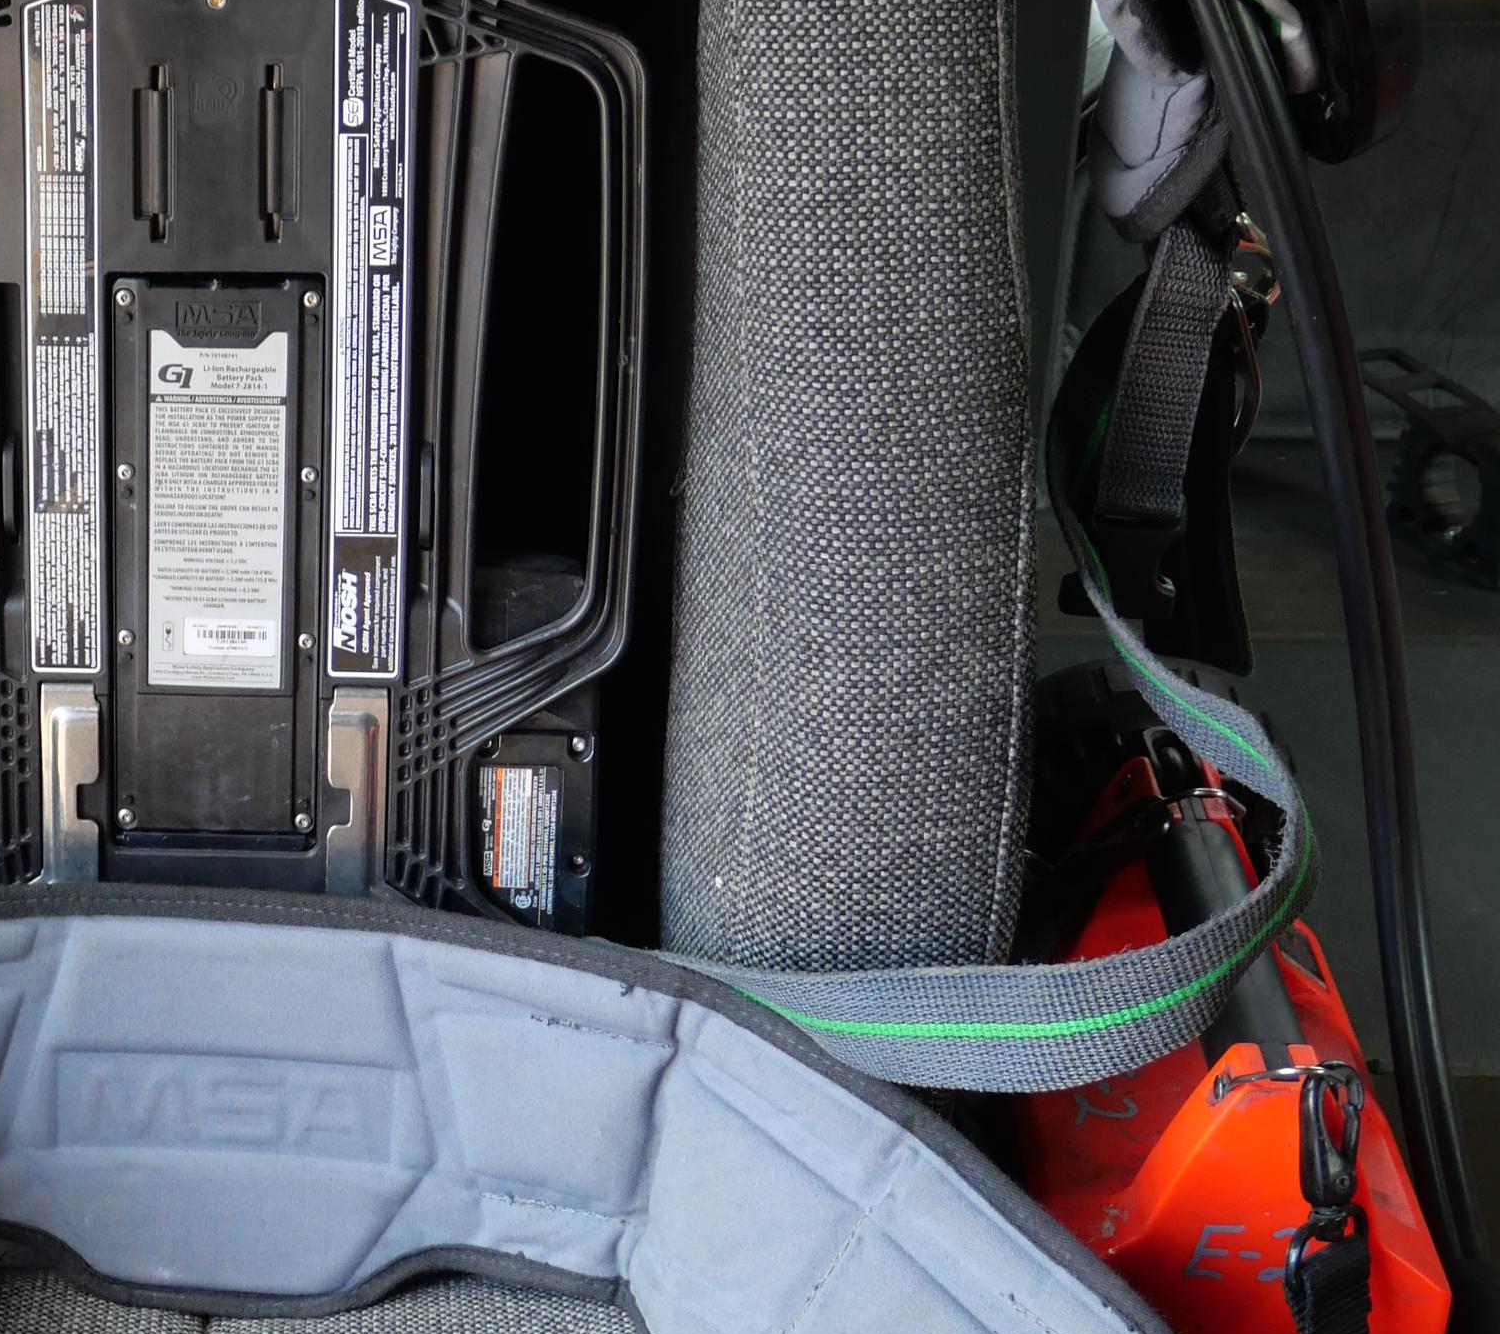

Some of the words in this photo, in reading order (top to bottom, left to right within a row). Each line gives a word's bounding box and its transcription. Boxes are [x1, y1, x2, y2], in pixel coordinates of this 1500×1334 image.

[348, 29, 356, 57] Model
[348, 59, 356, 97] Certified
[372, 209, 388, 262] MSA
[181, 303, 258, 325] MSA
[158, 364, 193, 389] G1
[226, 365, 276, 373] Rechargeable
[337, 572, 357, 653] NIOSH
[363, 608, 371, 629] Agent
[484, 852, 492, 874] MSA
